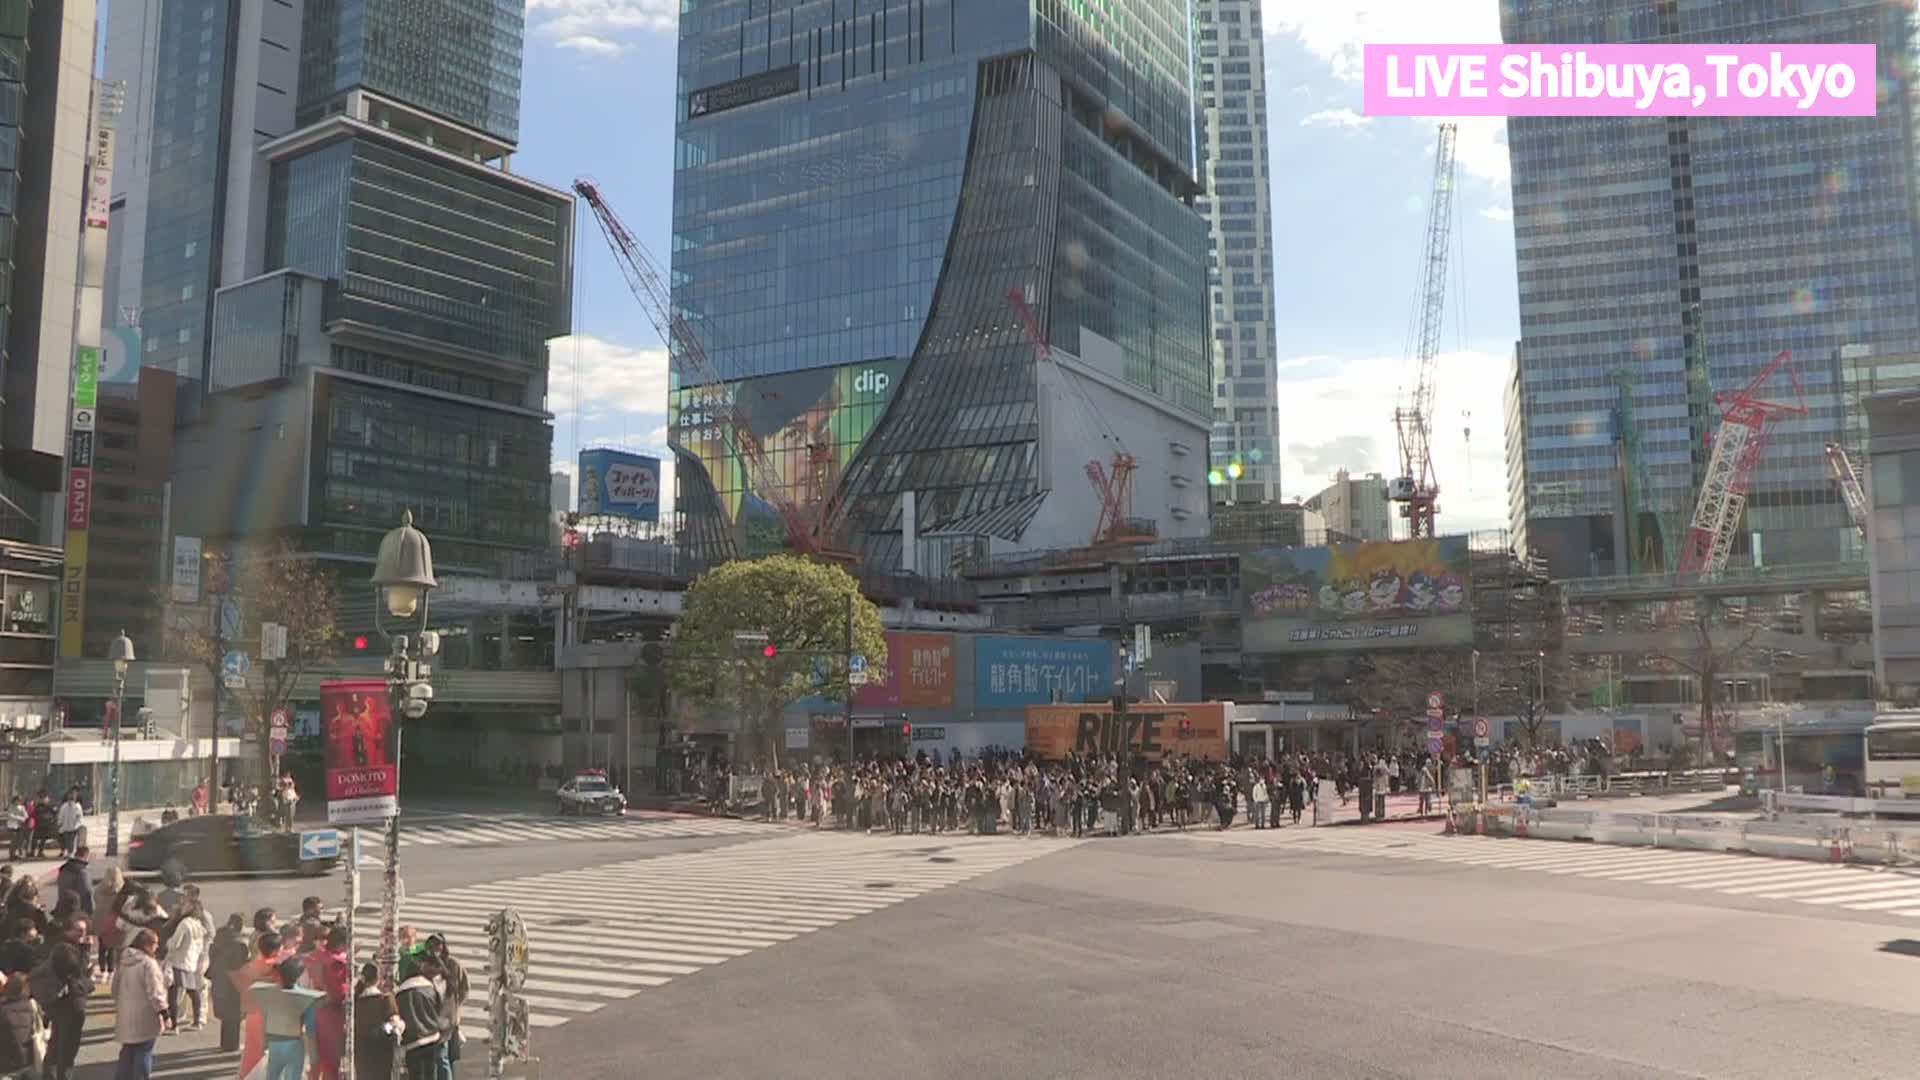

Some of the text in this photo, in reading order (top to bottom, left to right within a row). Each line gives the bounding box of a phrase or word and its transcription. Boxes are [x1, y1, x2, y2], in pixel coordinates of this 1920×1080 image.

[854, 369, 890, 394] dip
[680, 412, 713, 427] 仕事に
[64, 566, 82, 625] プロミス
[991, 663, 1099, 694] 龍角散ダイレクト
